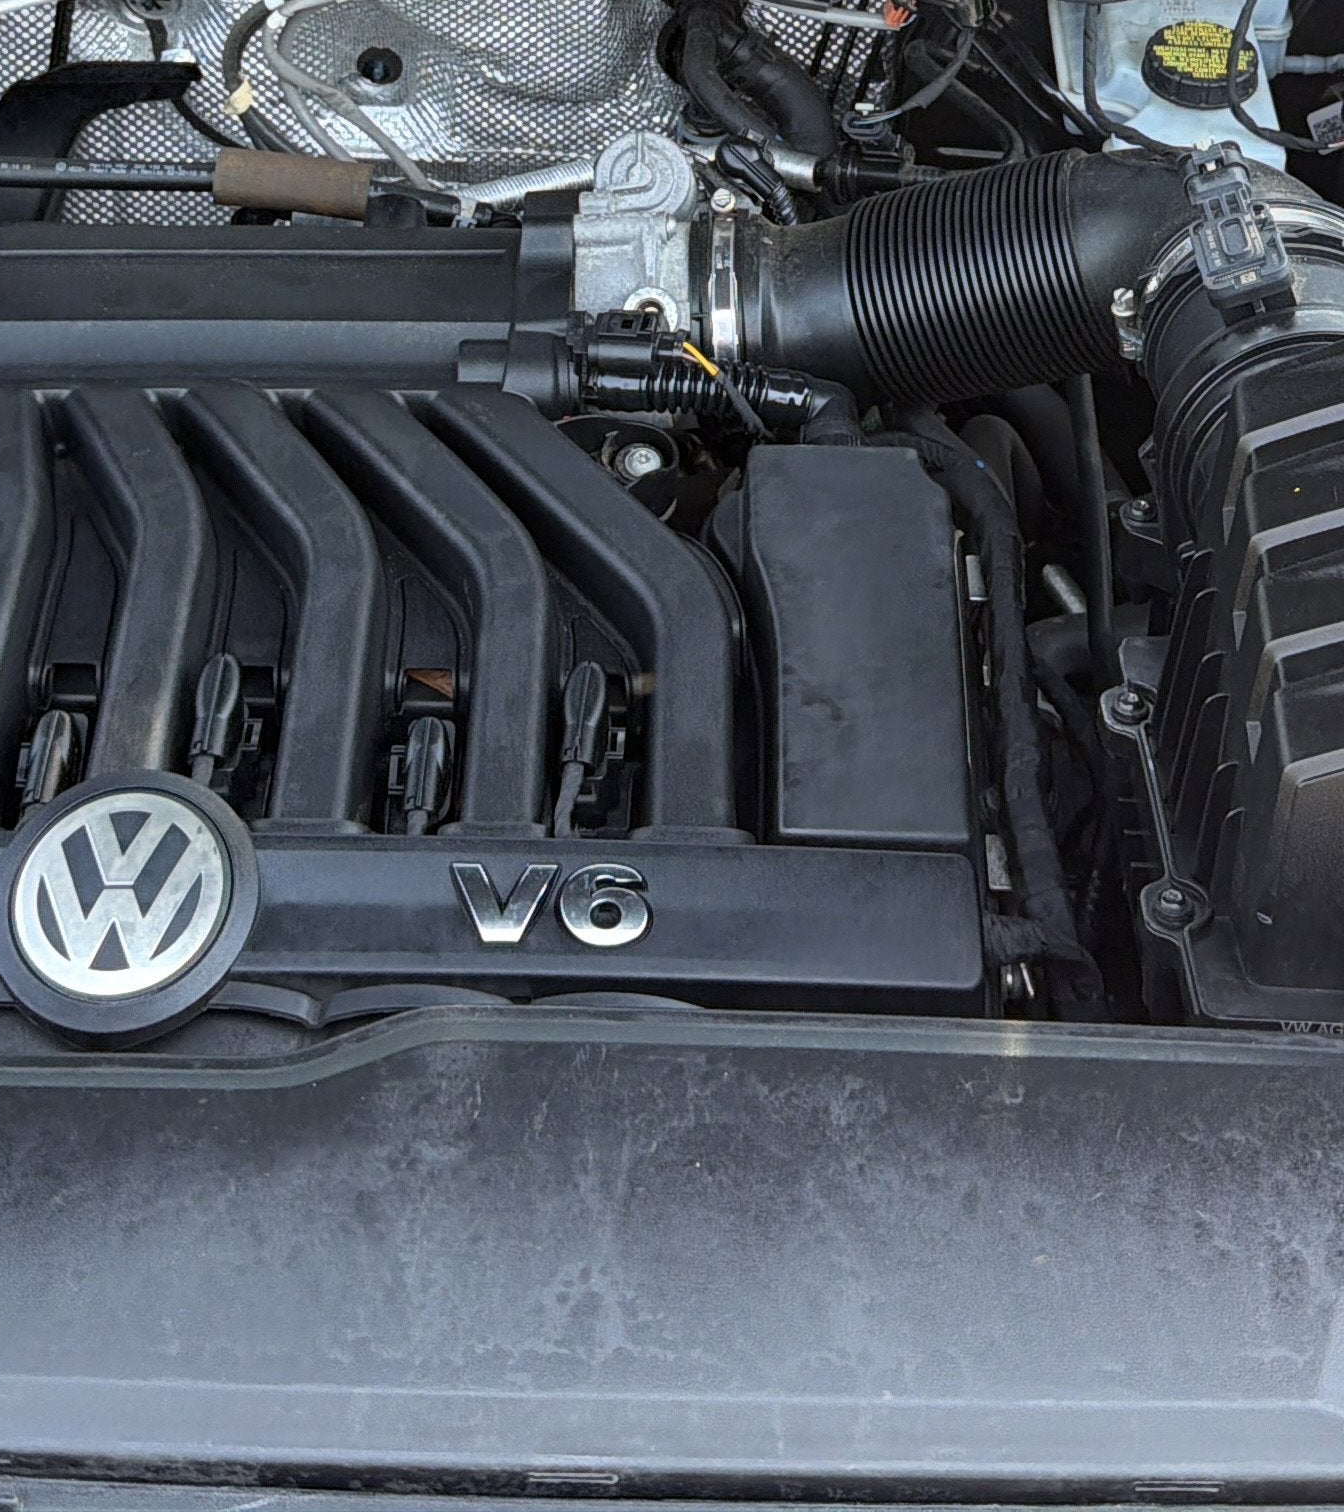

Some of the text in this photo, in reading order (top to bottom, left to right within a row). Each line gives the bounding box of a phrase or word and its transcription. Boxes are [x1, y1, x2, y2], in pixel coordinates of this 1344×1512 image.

[15, 792, 224, 995] VW
[451, 862, 652, 947] V6
[1279, 1020, 1344, 1035] VW AG
